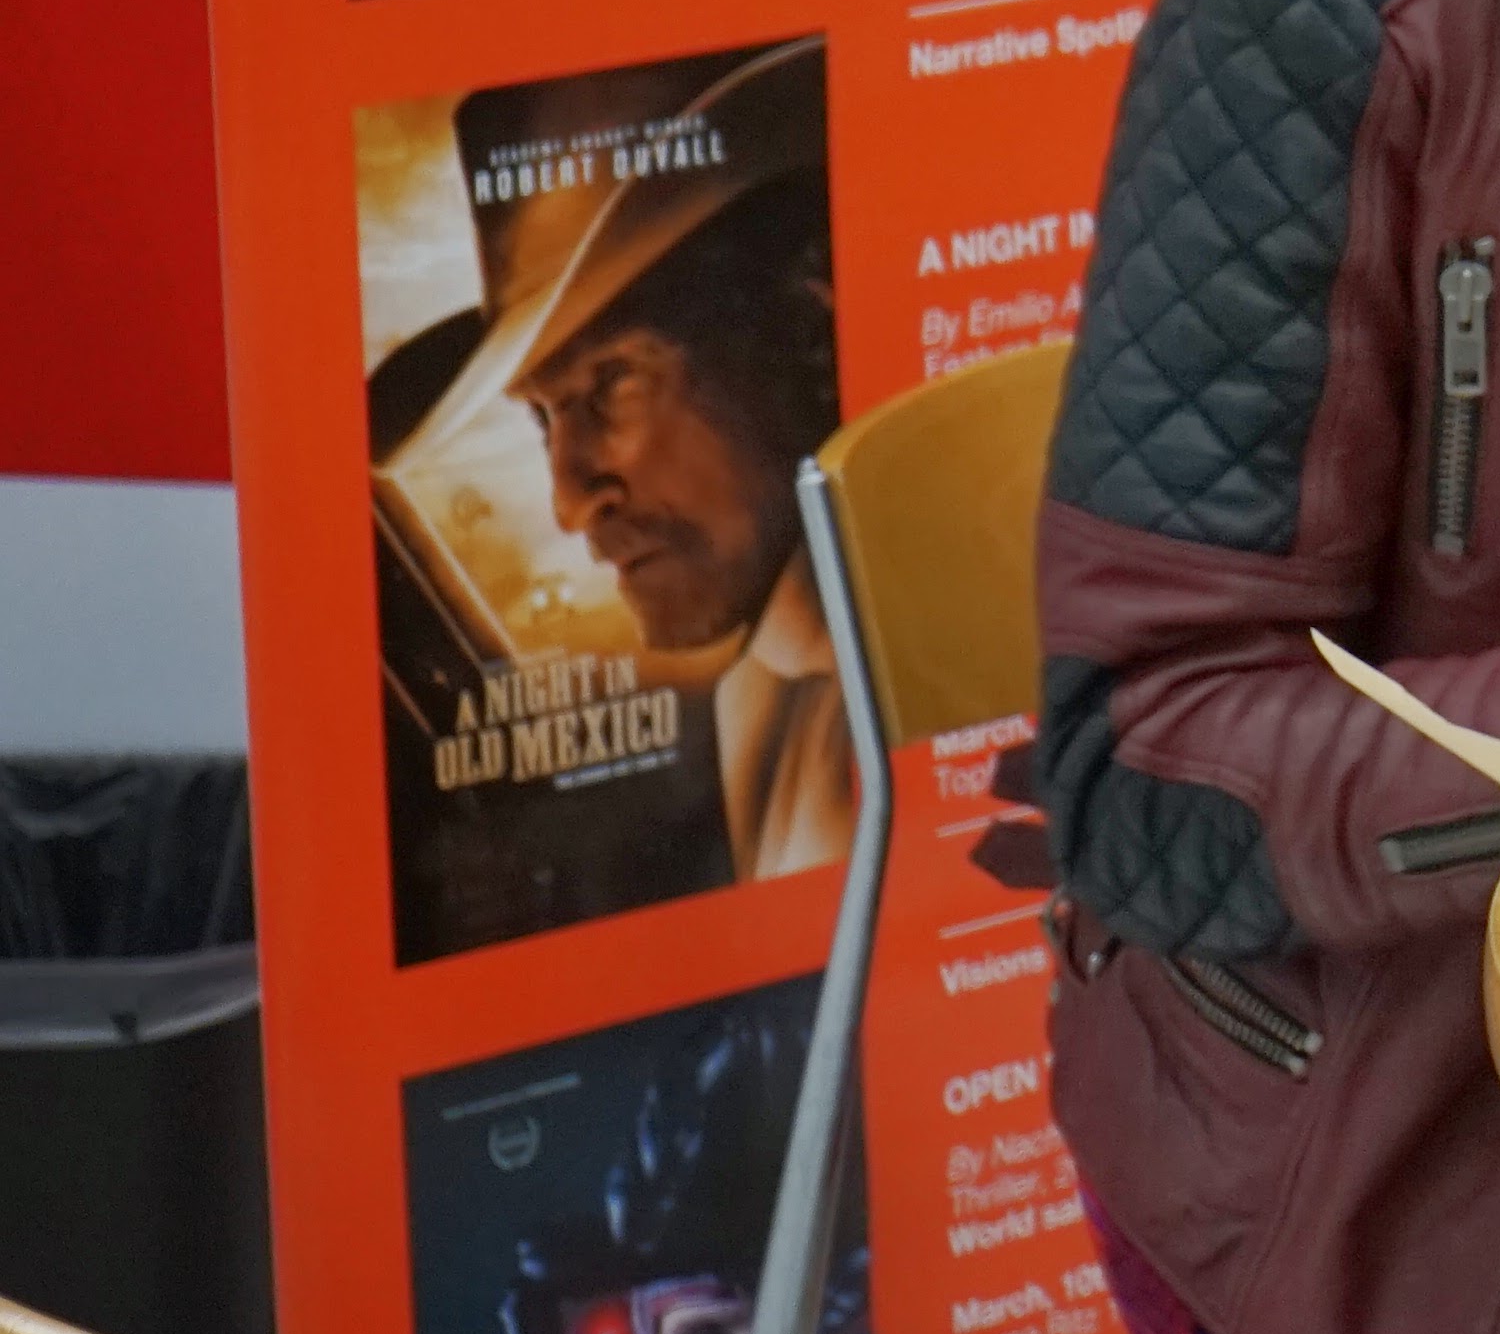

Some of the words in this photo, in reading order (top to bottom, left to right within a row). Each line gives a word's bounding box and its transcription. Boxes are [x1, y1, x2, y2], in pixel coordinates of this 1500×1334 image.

[909, 25, 1050, 79] Narrative
[917, 237, 946, 278] A
[951, 214, 1060, 269] NIGHT
[921, 306, 962, 350] By
[455, 688, 479, 733] A
[484, 653, 596, 724] NIGHT
[605, 656, 637, 697] IN
[435, 730, 505, 791] OLD
[511, 687, 678, 783] MEXICO
[940, 945, 1048, 997] Visions
[943, 1057, 1040, 1115] OPEN
[948, 1203, 1036, 1258] World
